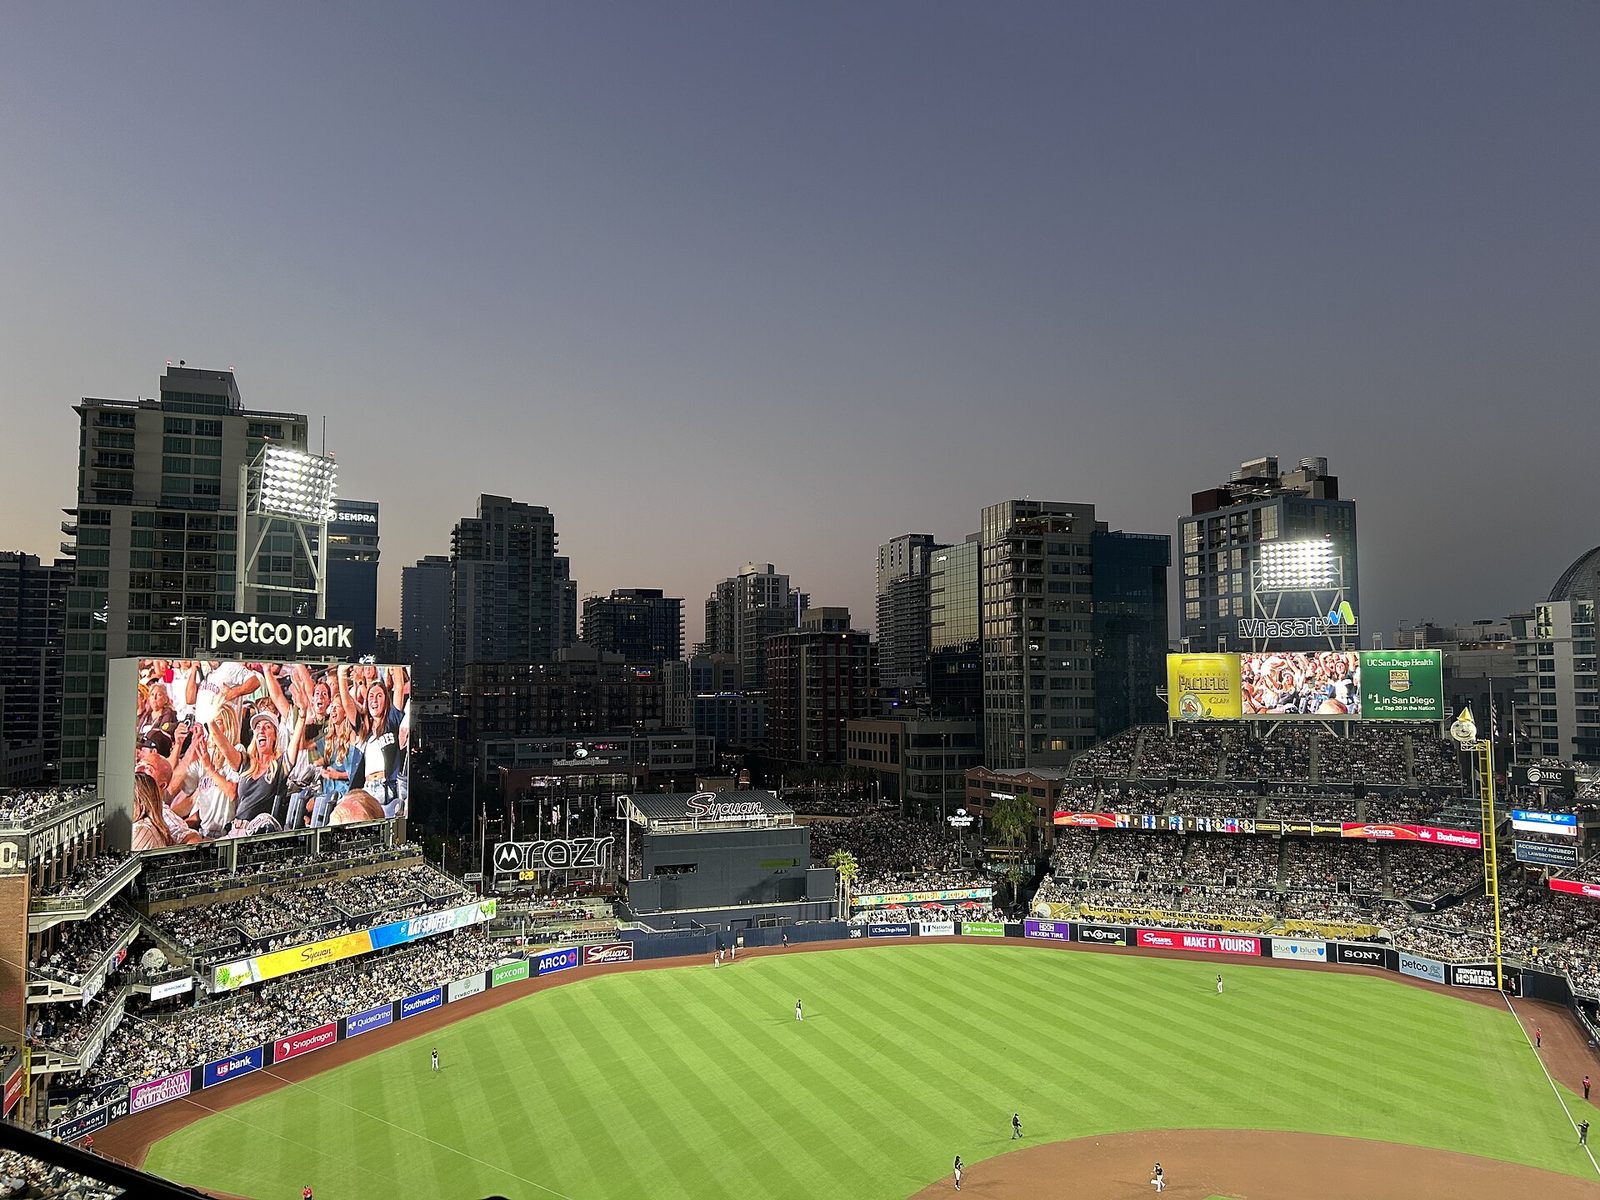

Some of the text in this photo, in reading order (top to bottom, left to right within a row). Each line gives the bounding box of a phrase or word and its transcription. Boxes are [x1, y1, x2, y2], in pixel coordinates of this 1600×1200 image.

[338, 512, 376, 523] SEMPRA
[210, 616, 353, 652] petco park
[1241, 617, 1321, 638] Viasat
[1392, 659, 1410, 667] Diego
[1179, 675, 1229, 692] PACIFICO
[1368, 693, 1380, 704] #1
[1391, 696, 1408, 704] San
[1409, 696, 1435, 705] Diego
[1541, 771, 1562, 780] MRC
[685, 792, 764, 822] Sycuan
[1363, 825, 1394, 838] Sycuan
[1437, 831, 1478, 845] Budweiser
[526, 836, 615, 870] razr
[1089, 906, 1123, 914] CHROME
[1143, 933, 1172, 944] Sycuan
[1183, 936, 1255, 952] MAKE IT YOURS!
[301, 947, 331, 962] Sycuan
[539, 954, 567, 971] ARCO
[587, 946, 628, 963] Sycuan
[1344, 950, 1380, 960] SONY
[1401, 960, 1428, 972] petco
[1456, 974, 1496, 986] HOMERS
[403, 996, 436, 1012] Southwest
[357, 1010, 391, 1028] QuidelOrtho
[293, 1031, 333, 1050] Snapdragon
[217, 1056, 252, 1075] us bank
[167, 1074, 186, 1088] BAJA
[133, 1083, 188, 1108] CALIFORNIA
[111, 1102, 128, 1119] 342
[62, 1114, 104, 1137] AGRAMONT
